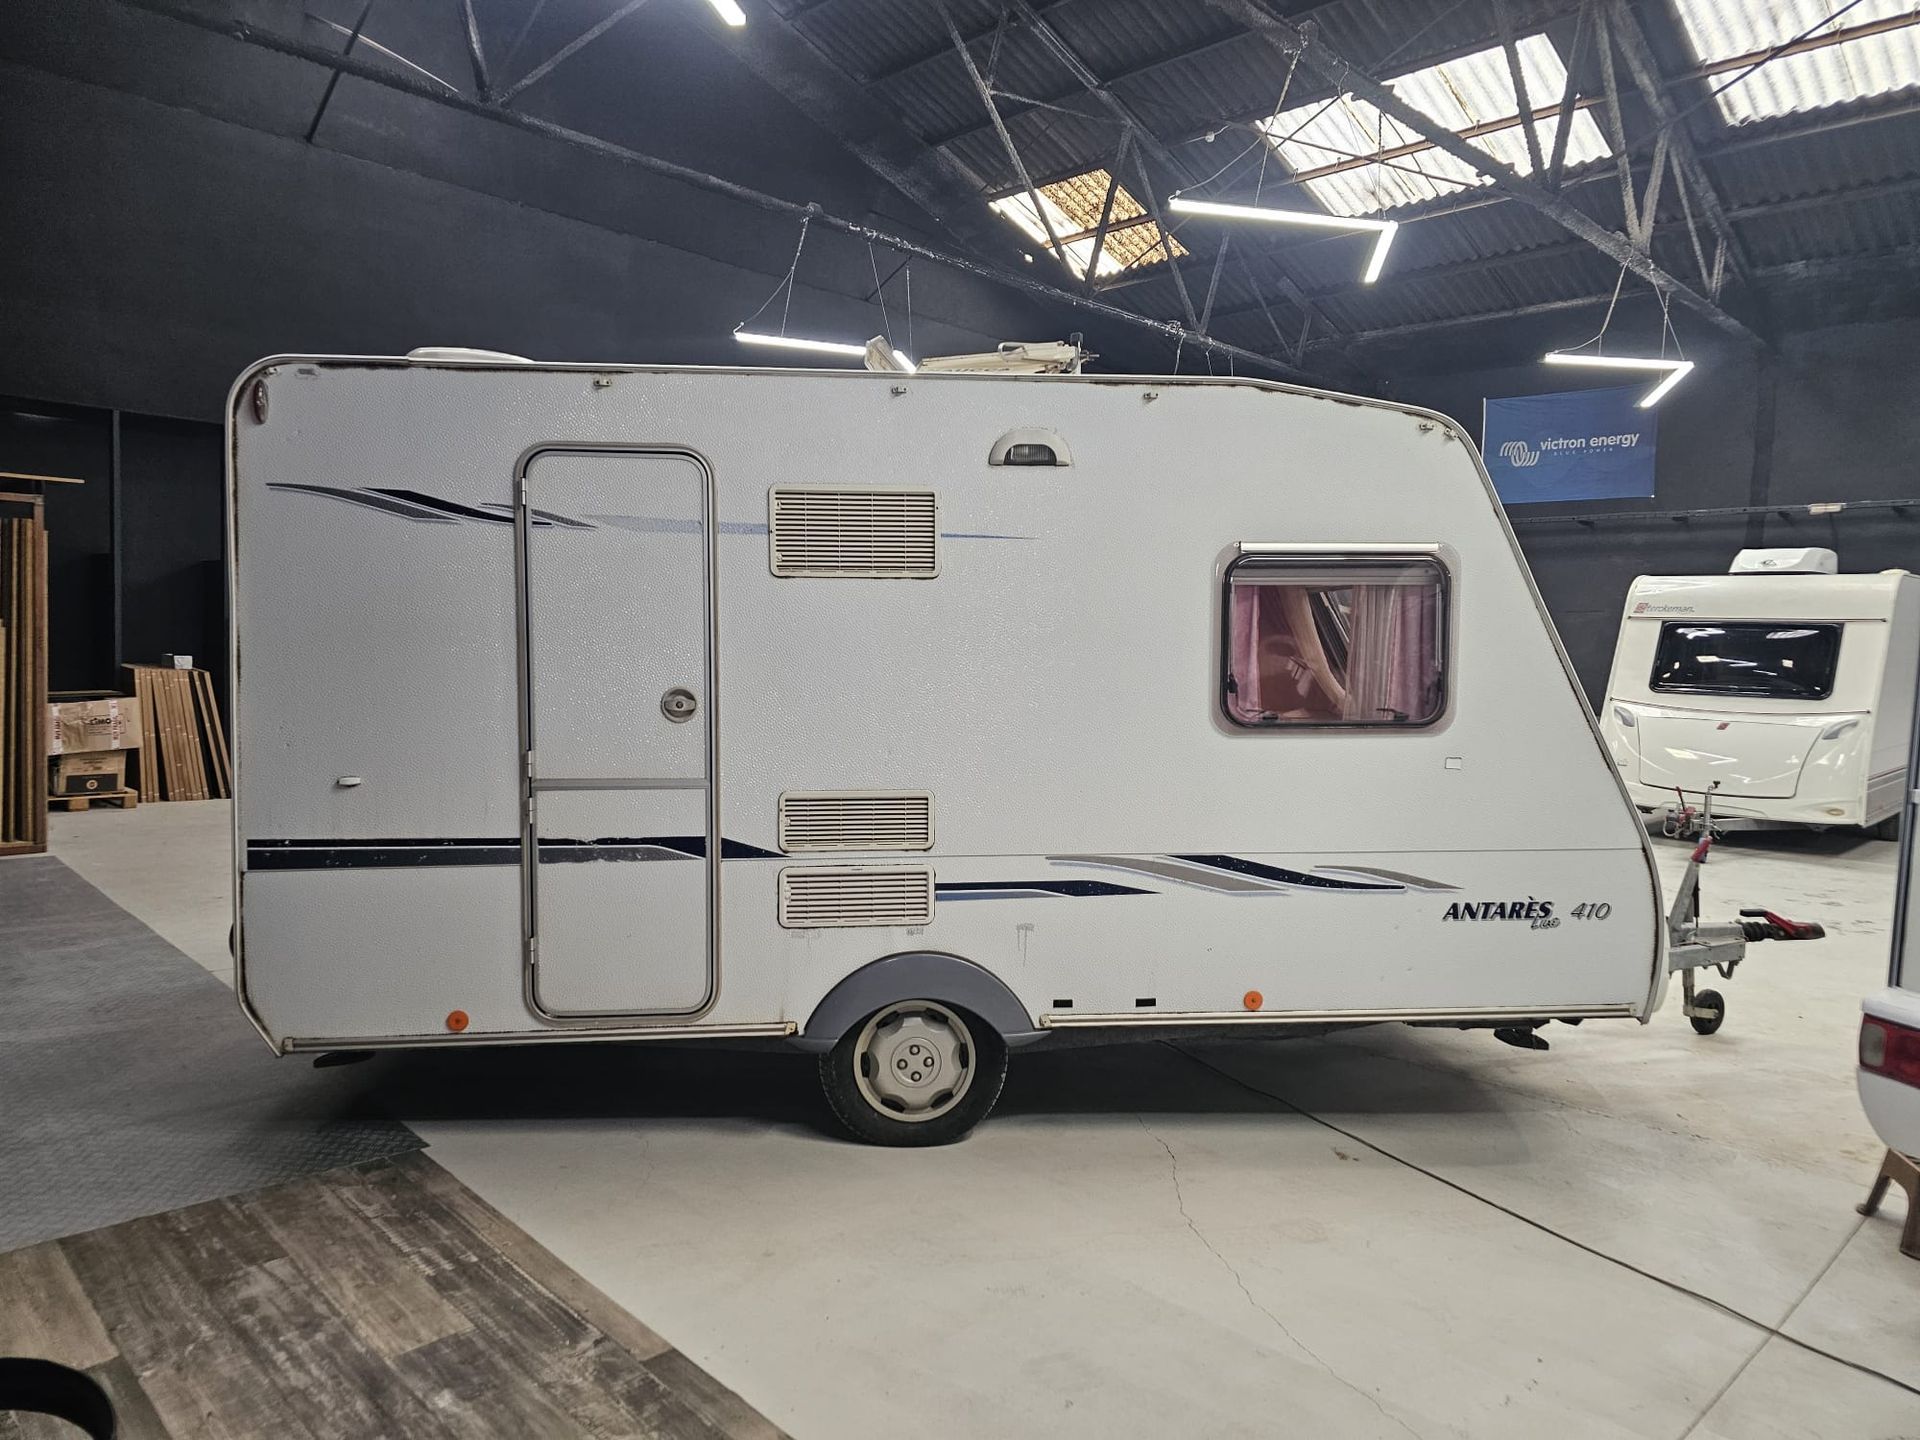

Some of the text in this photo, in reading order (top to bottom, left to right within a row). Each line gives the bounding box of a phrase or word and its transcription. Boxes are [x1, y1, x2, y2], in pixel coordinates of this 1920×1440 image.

[1540, 433, 1640, 450] victron energy
[1442, 895, 1612, 920] ANTARÈS 410
